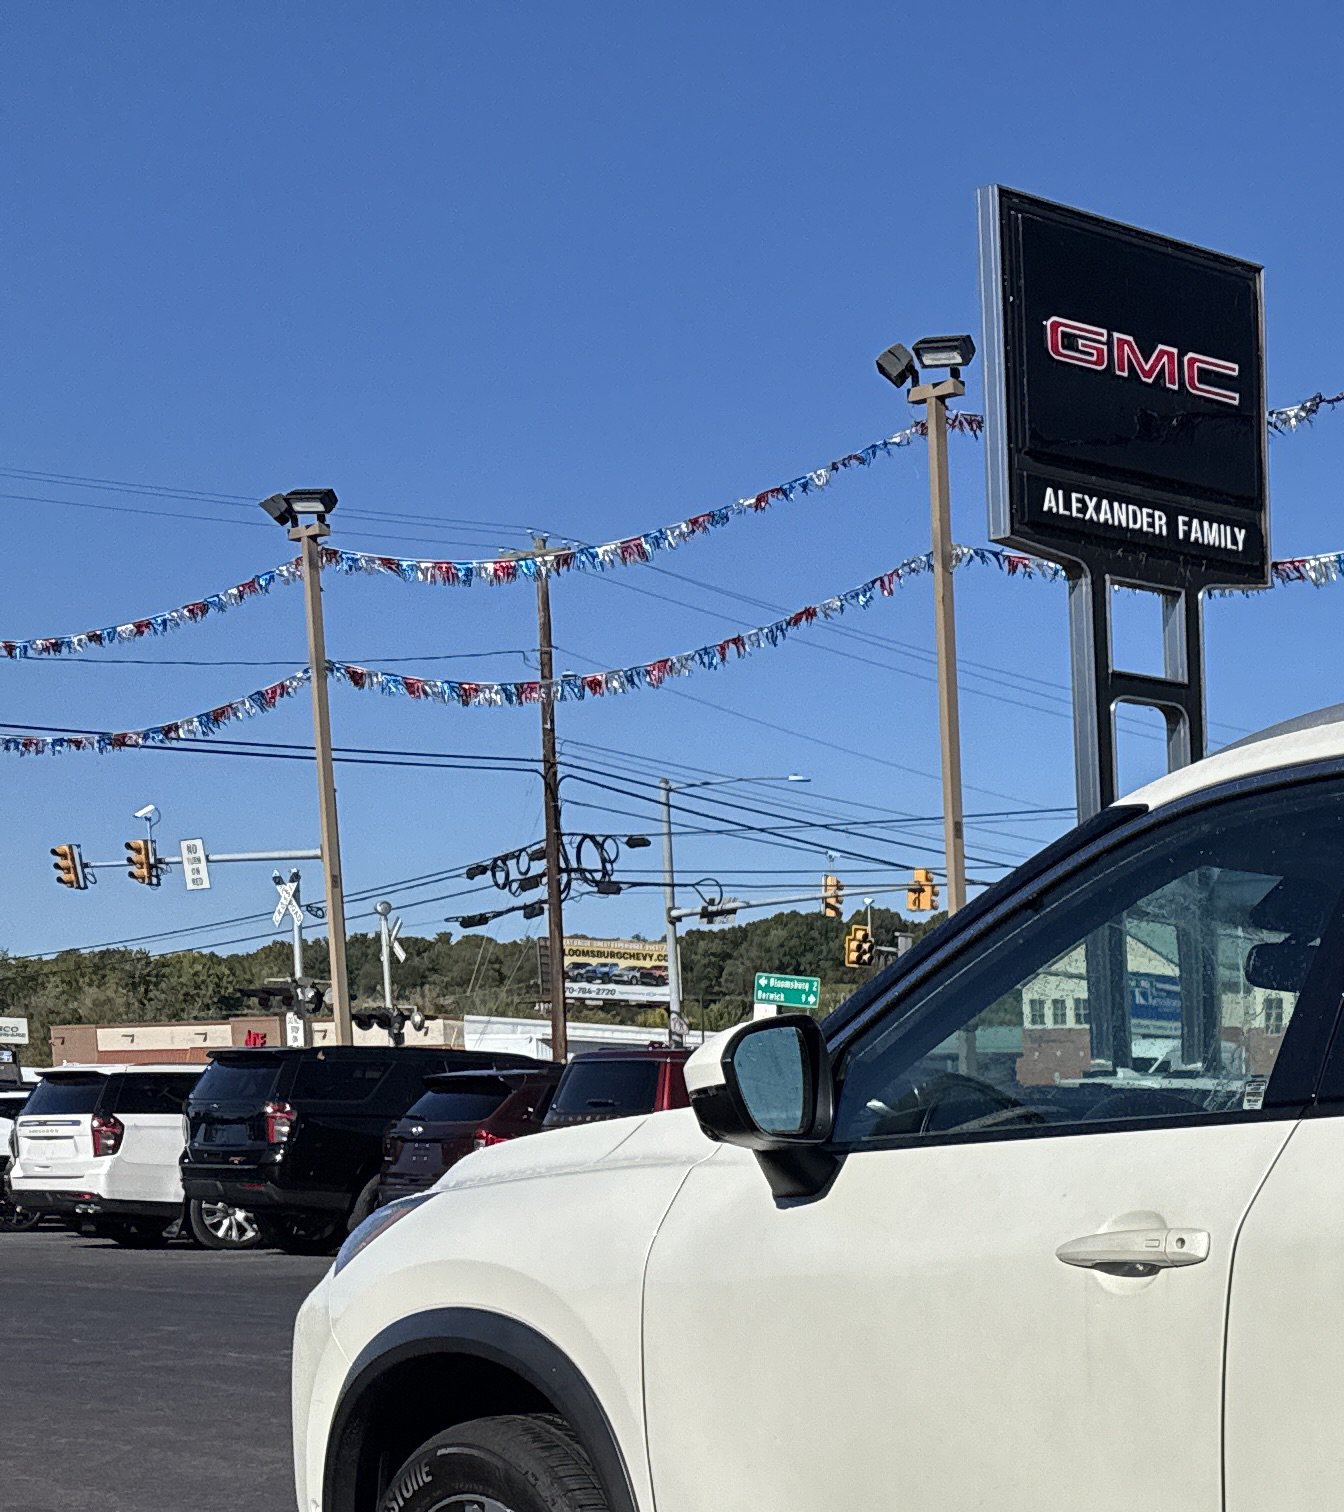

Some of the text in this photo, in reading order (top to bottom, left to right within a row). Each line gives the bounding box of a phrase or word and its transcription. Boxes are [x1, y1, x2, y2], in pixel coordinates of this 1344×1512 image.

[1046, 315, 1239, 406] GMC
[1042, 486, 1247, 552] ALEXANDER FAMILY
